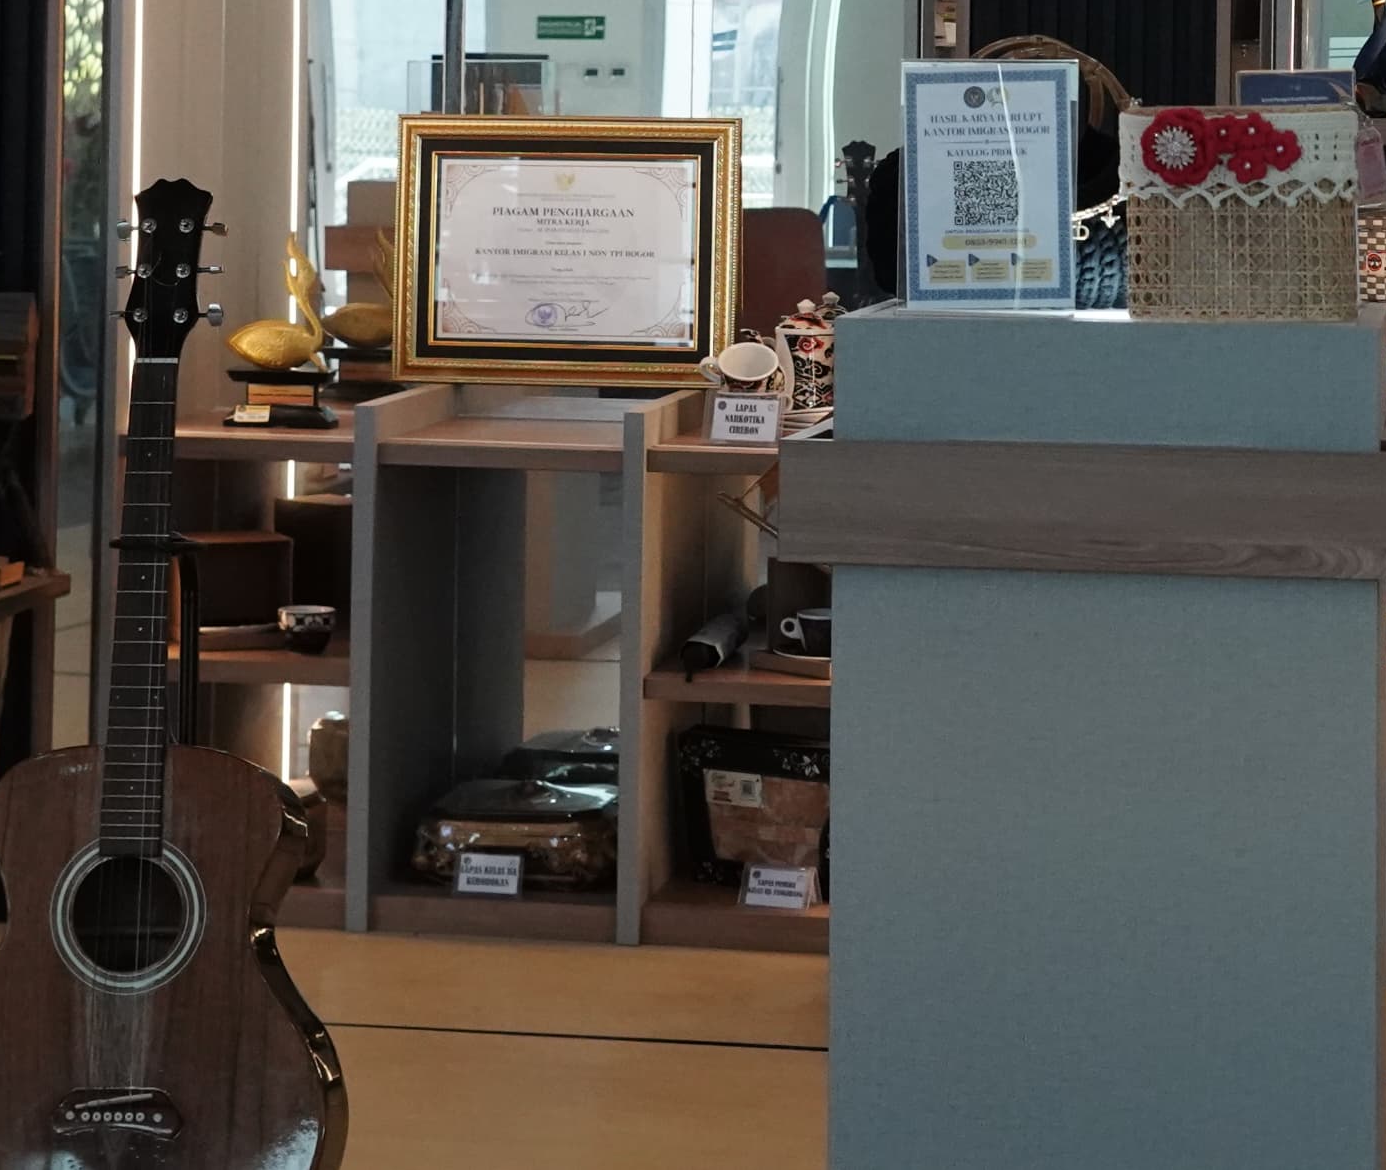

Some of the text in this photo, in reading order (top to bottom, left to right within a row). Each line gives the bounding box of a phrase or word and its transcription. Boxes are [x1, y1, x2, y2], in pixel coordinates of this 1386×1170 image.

[930, 114, 957, 123] HASIL
[962, 114, 995, 123] KARYA
[997, 113, 1021, 122] DRI
[924, 127, 965, 137] KANTOR
[968, 126, 1011, 136] IMIGRAS
[947, 148, 989, 157] KATALOG
[492, 207, 635, 218] PIAGAM PENGHARGAAN
[536, 218, 590, 227] MITRA KERJA
[475, 247, 510, 256] KANTOR
[512, 247, 553, 257] IMIGRASI
[554, 248, 582, 257] KELAS
[588, 249, 607, 258] NON
[610, 249, 624, 258] TPI
[625, 249, 655, 259] BOGOR
[735, 404, 757, 412] LAPAS
[725, 414, 765, 424] NARKOTIKA
[729, 425, 759, 434] CIREBON
